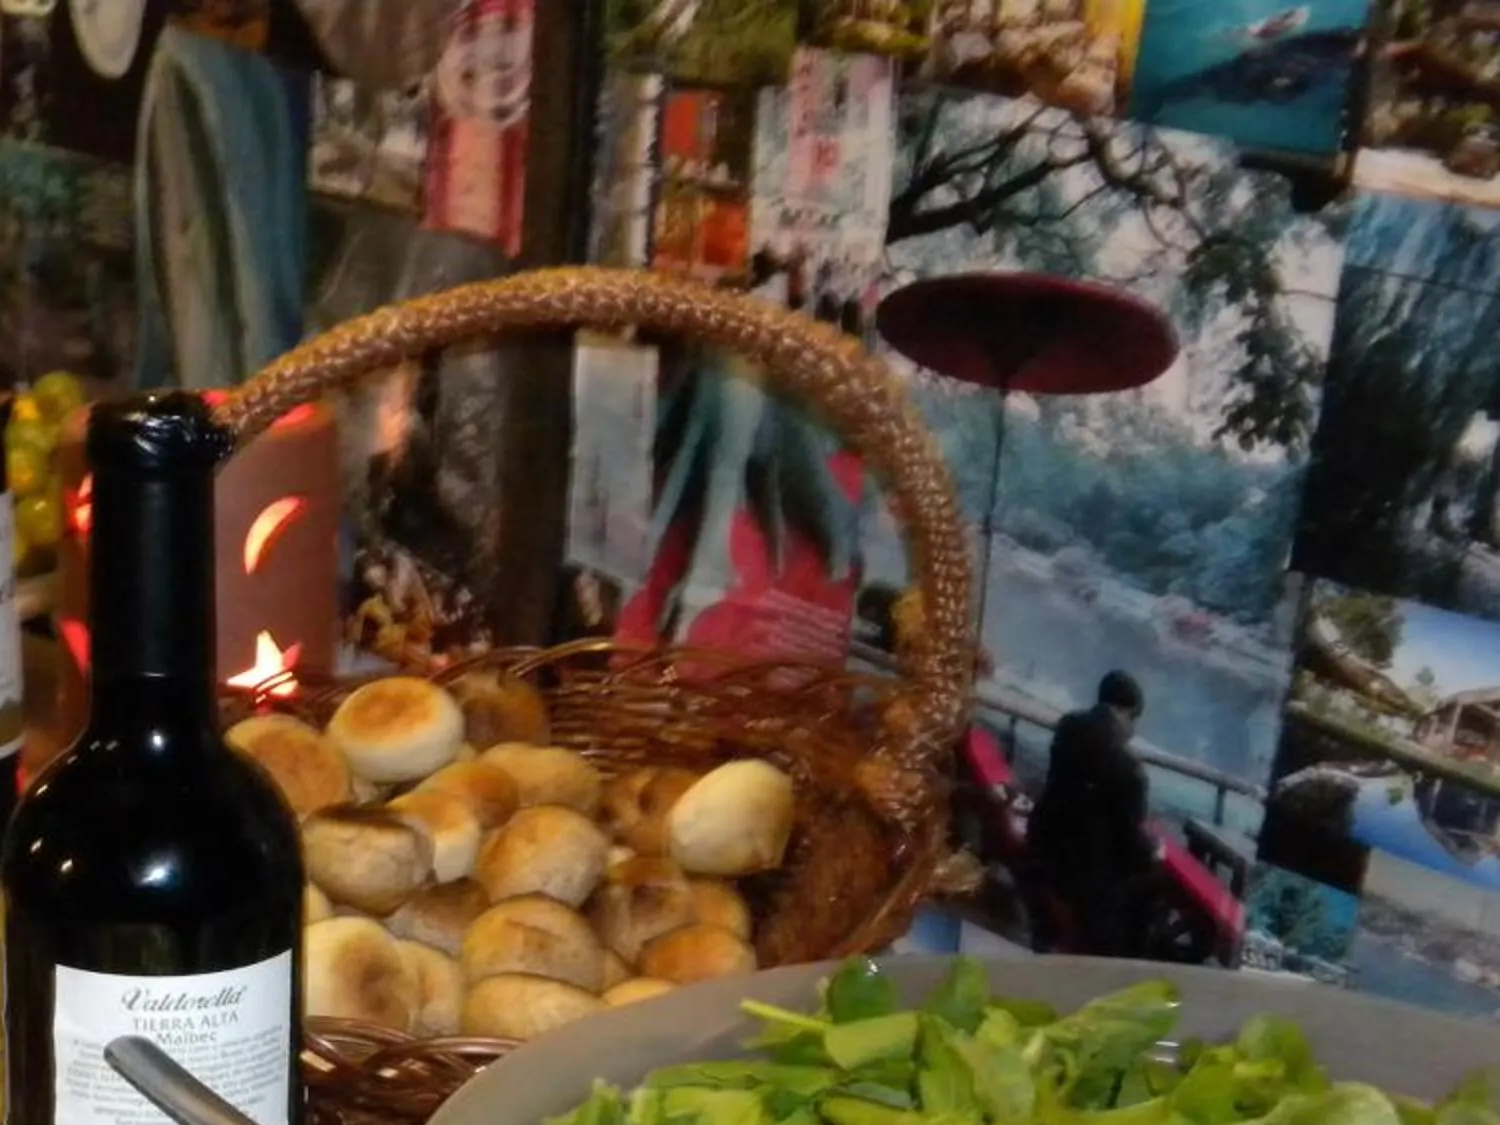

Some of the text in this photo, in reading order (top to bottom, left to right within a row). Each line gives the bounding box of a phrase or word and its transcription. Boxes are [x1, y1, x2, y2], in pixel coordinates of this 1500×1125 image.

[132, 1011, 240, 1032] TIERRA ALTA
[156, 1029, 218, 1046] Malbec
